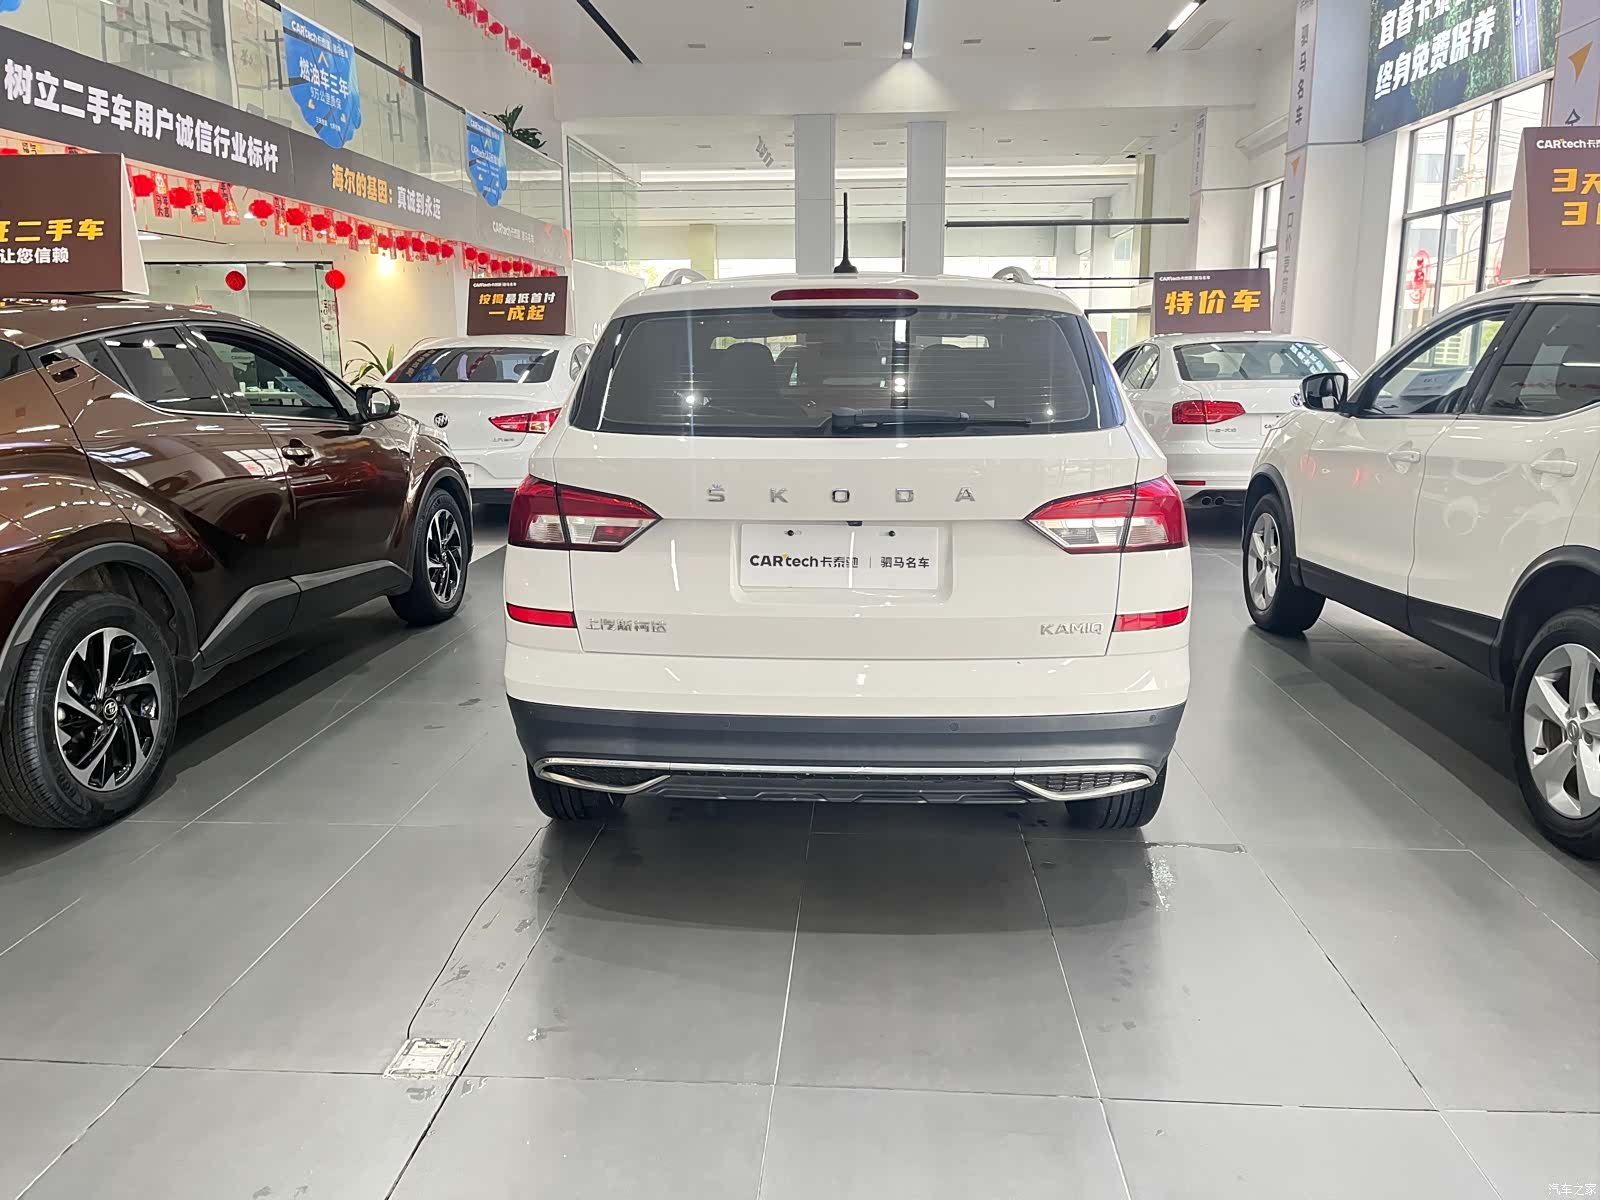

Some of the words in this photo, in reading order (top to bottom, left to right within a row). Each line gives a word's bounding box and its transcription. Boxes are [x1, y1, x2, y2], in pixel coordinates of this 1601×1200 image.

[1374, 5, 1496, 100] 终身免费保养
[299, 56, 350, 98] 燃油车三年
[4, 58, 279, 173] 树立二手车用户诚信行业标杆
[1562, 201, 1601, 226] 3
[479, 292, 556, 305] 按揭最低首付
[1164, 289, 1262, 316] 特价车
[488, 304, 546, 321] 一成起
[880, 556, 930, 569] 驷马名车
[1040, 622, 1103, 635] KAMIQ
